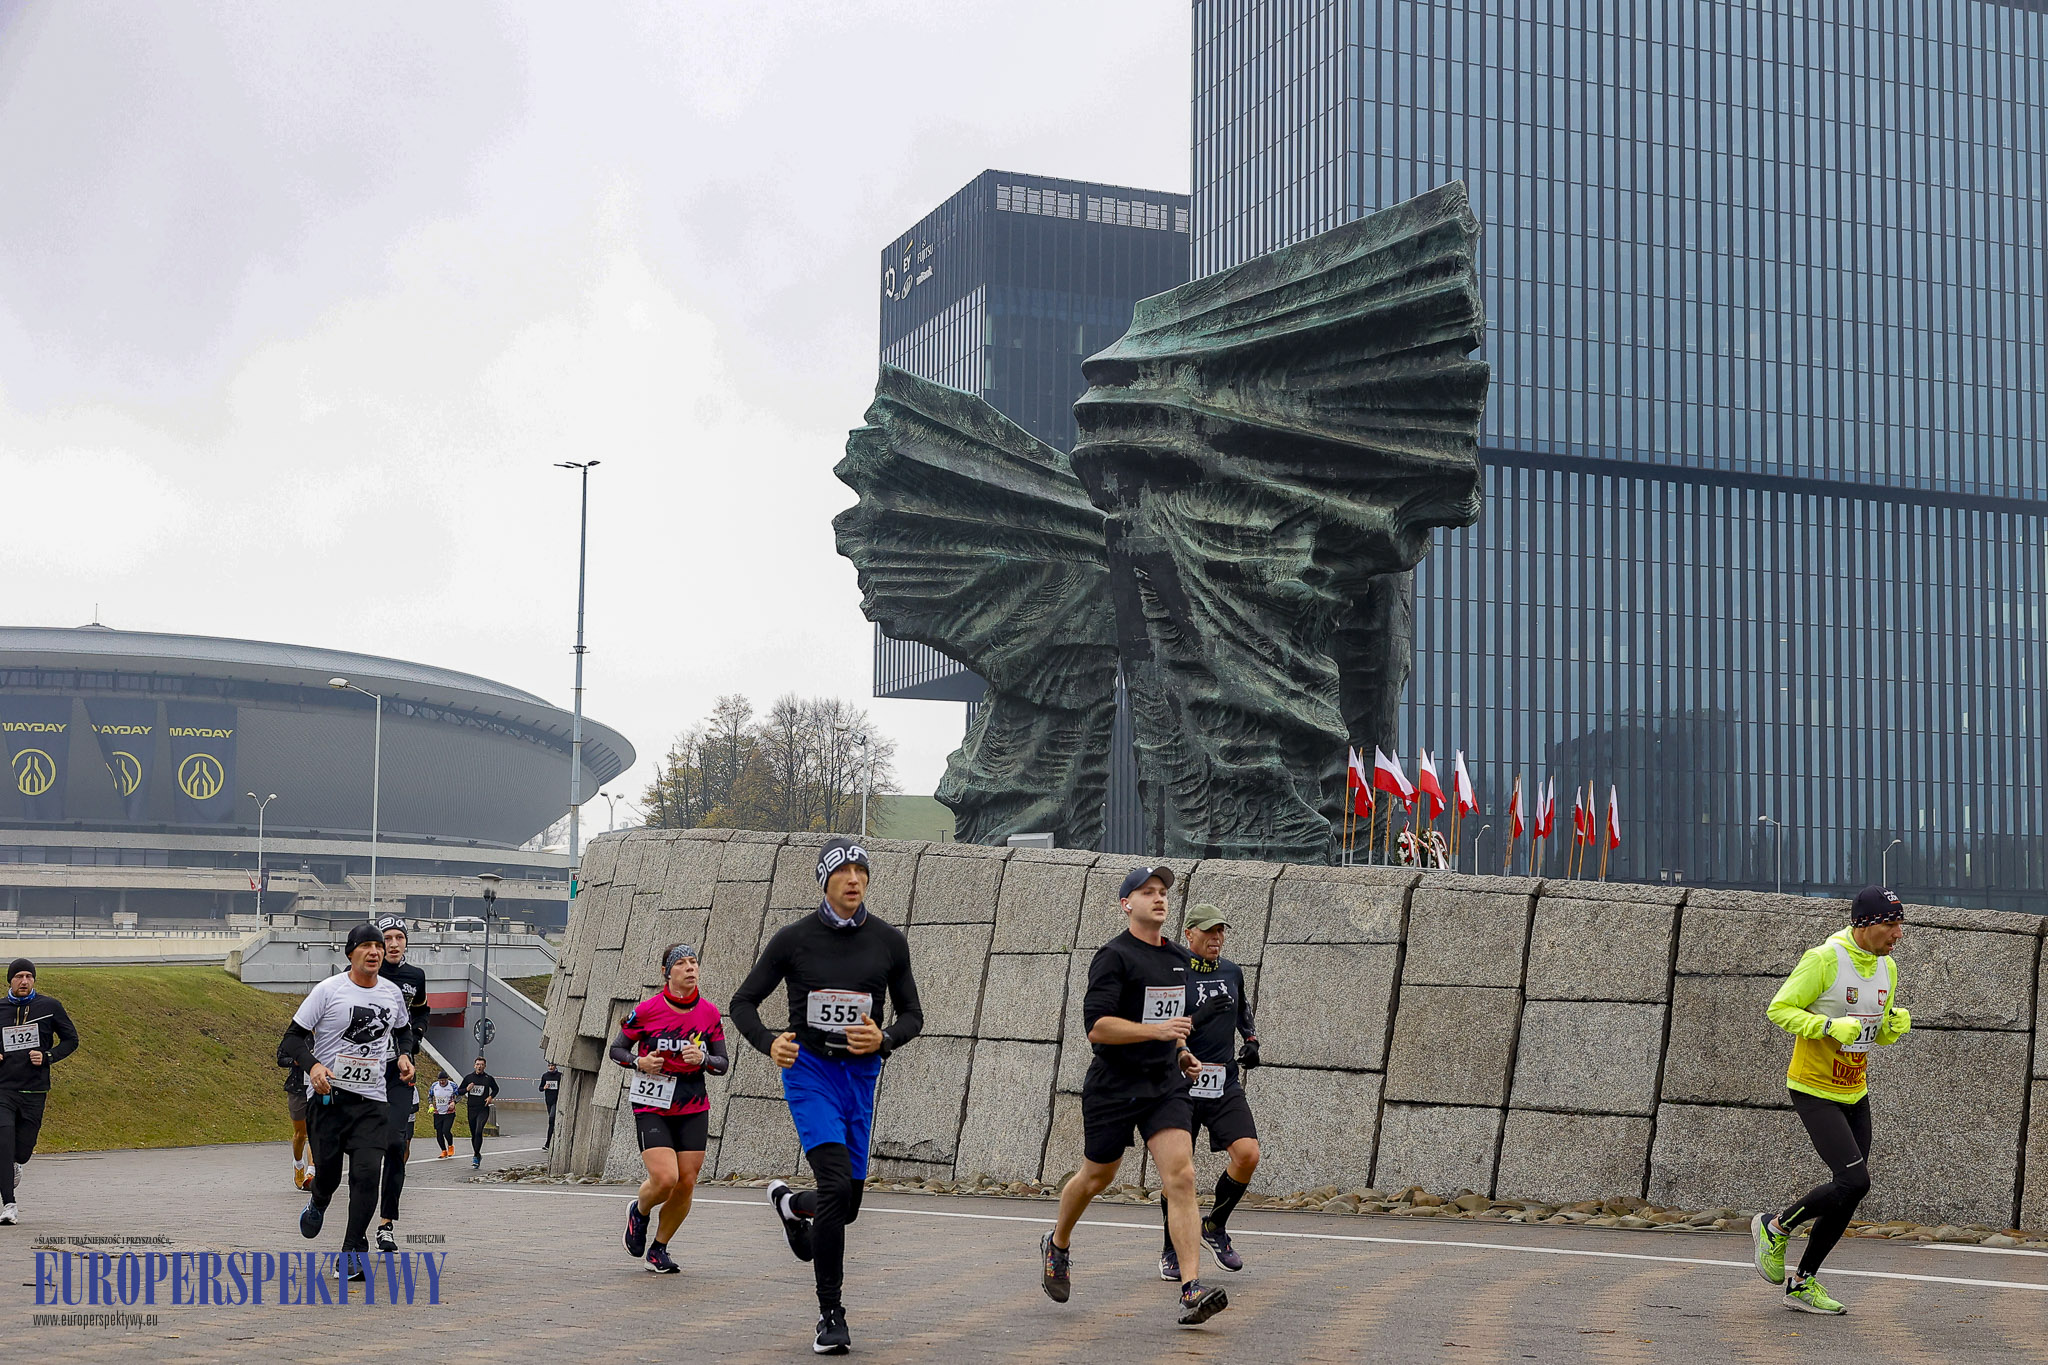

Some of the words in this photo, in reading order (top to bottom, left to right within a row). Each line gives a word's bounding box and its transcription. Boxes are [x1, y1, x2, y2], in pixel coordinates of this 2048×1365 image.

[903, 253, 911, 273] EY
[2, 722, 67, 733] MAYDAY
[169, 727, 234, 739] MAYDAY
[820, 1003, 858, 1023] 555
[1154, 999, 1180, 1018] 347
[10, 1032, 32, 1044] 132
[1855, 1025, 1878, 1042] 13
[656, 1038, 708, 1053] BUA
[341, 1065, 372, 1082] 243
[638, 1080, 664, 1098] 521
